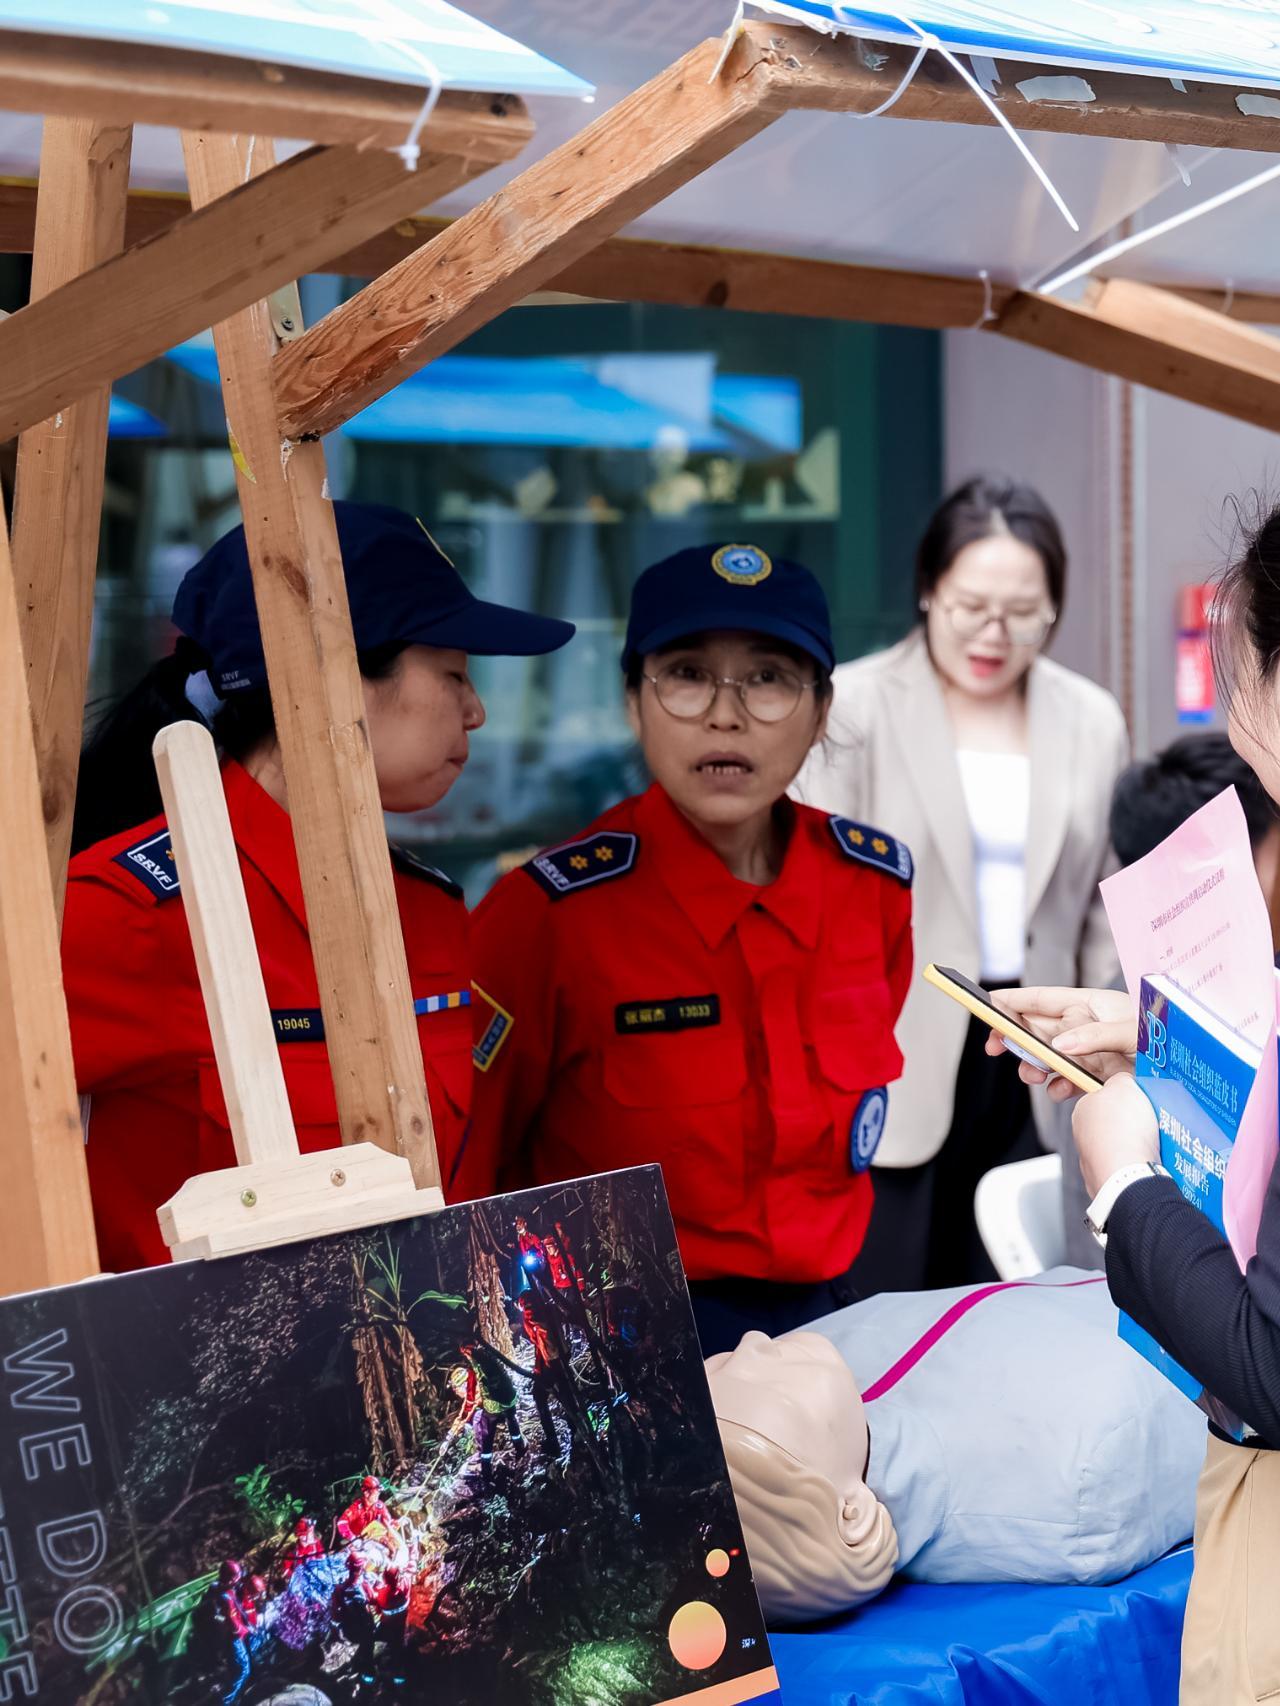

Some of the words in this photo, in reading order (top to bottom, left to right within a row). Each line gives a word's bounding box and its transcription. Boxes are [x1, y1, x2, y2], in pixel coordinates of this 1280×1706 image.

[133, 852, 173, 884] SRVF
[277, 1017, 311, 1031] 19045
[1145, 1010, 1167, 1068] B
[1170, 1035, 1238, 1113] 深圳社会组织蓝皮书
[1174, 1152, 1209, 1196] 发展报告
[3, 1327, 92, 1481] WE
[36, 1509, 124, 1655] DO
